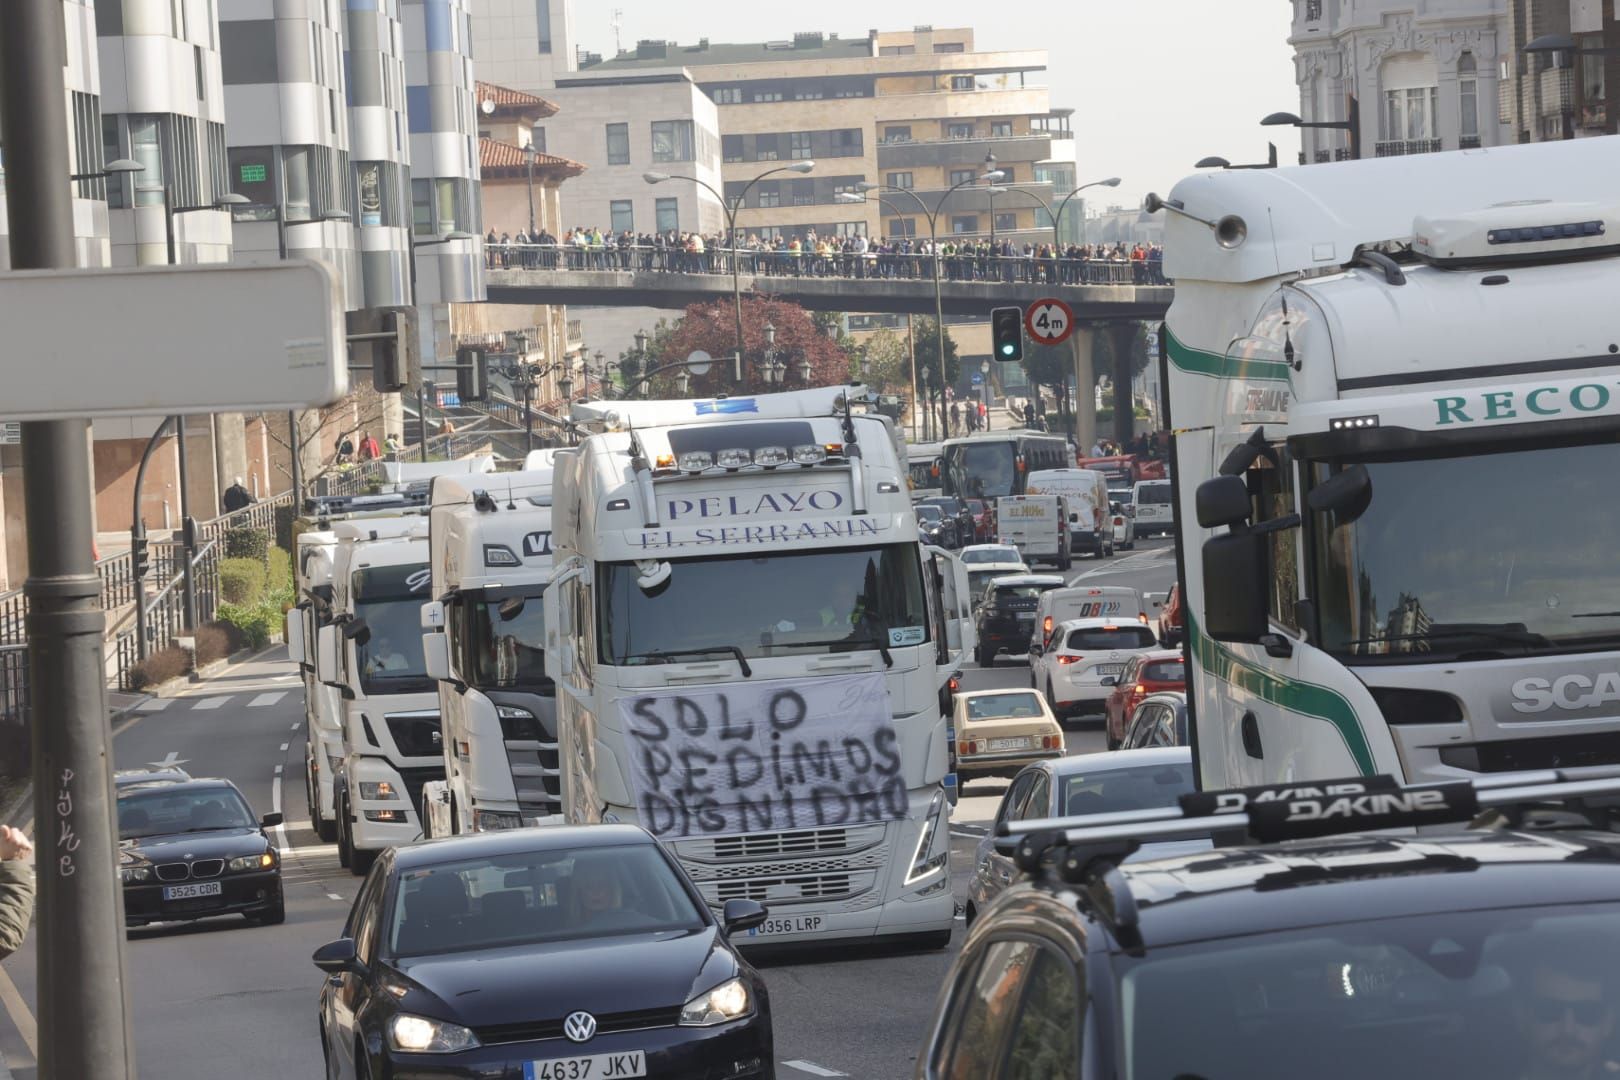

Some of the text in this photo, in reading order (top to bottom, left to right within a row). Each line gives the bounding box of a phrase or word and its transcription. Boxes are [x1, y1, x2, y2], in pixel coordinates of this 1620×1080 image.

[1433, 382, 1620, 425] RECO
[668, 490, 843, 520] PELAYO
[642, 531, 684, 549] EL
[631, 689, 807, 742] SOLO
[170, 886, 196, 898] 3525
[758, 917, 822, 934] 0356 LRP
[540, 1054, 640, 1080] 4637 JKV
